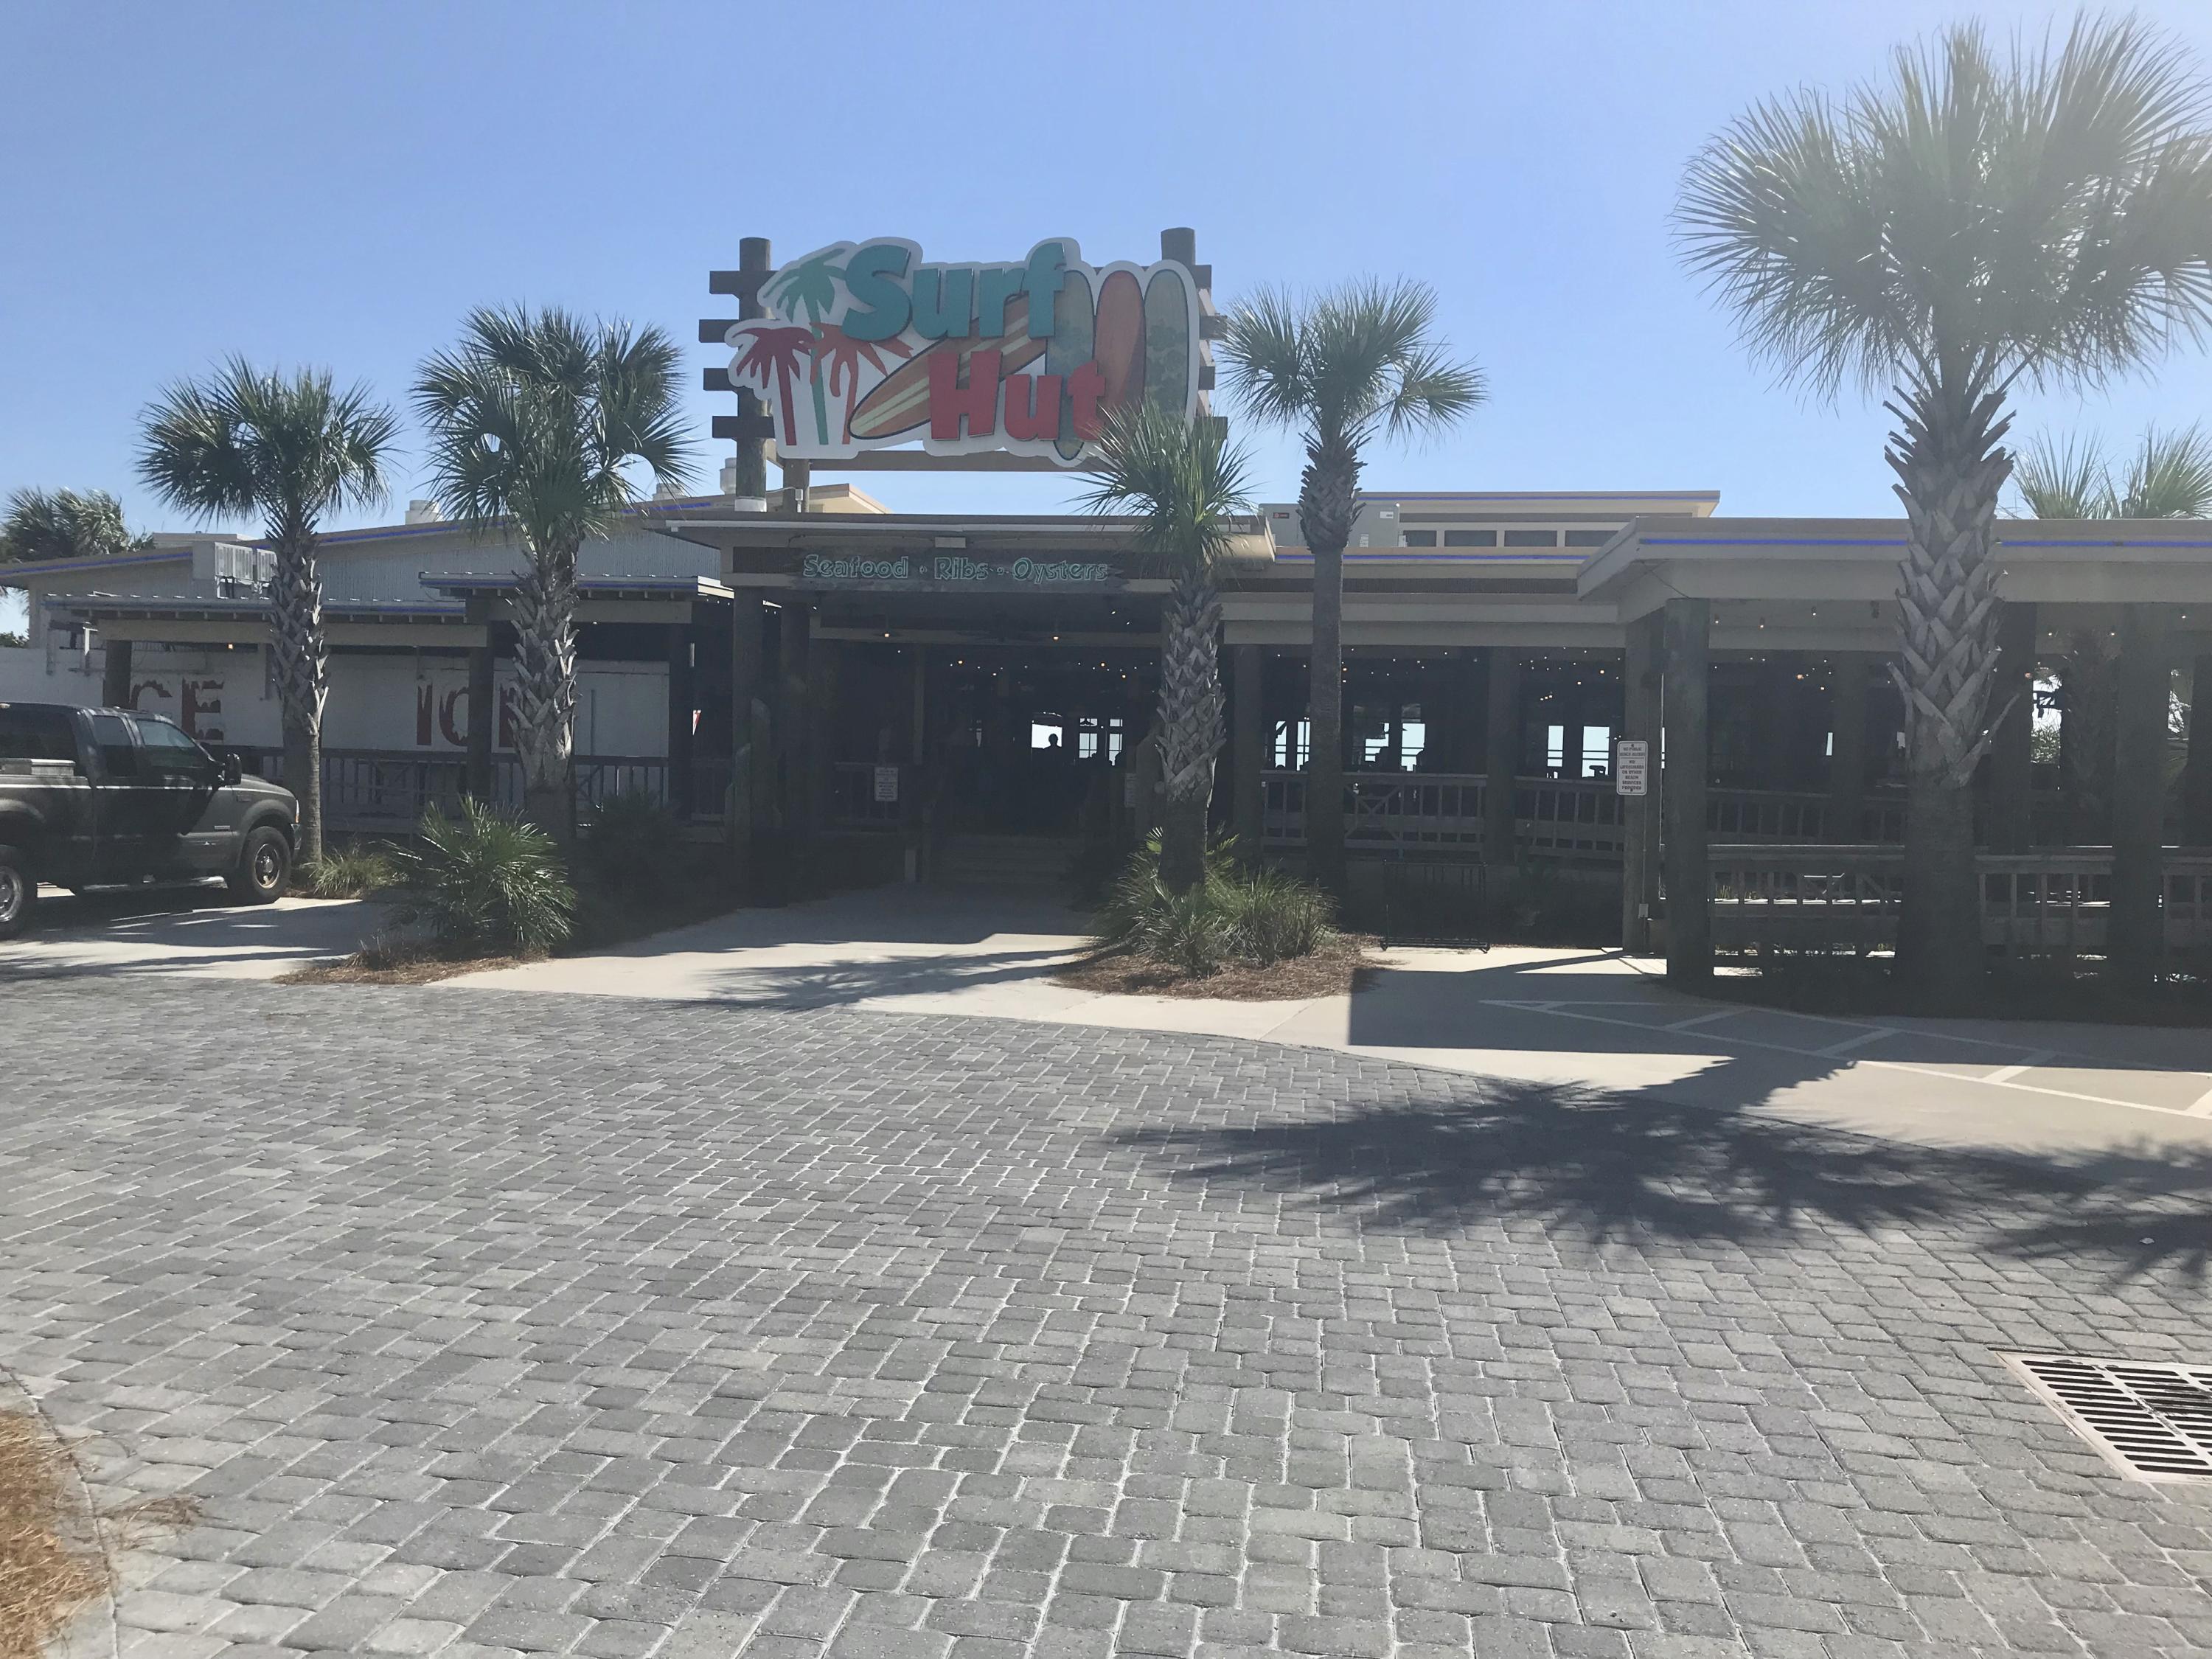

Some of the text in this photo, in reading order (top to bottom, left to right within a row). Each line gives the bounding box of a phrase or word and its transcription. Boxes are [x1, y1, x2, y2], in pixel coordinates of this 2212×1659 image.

[842, 242, 1066, 341] Surf
[930, 351, 1107, 442] Hut
[803, 554, 909, 579] Seafood
[1012, 557, 1108, 584] Oysters
